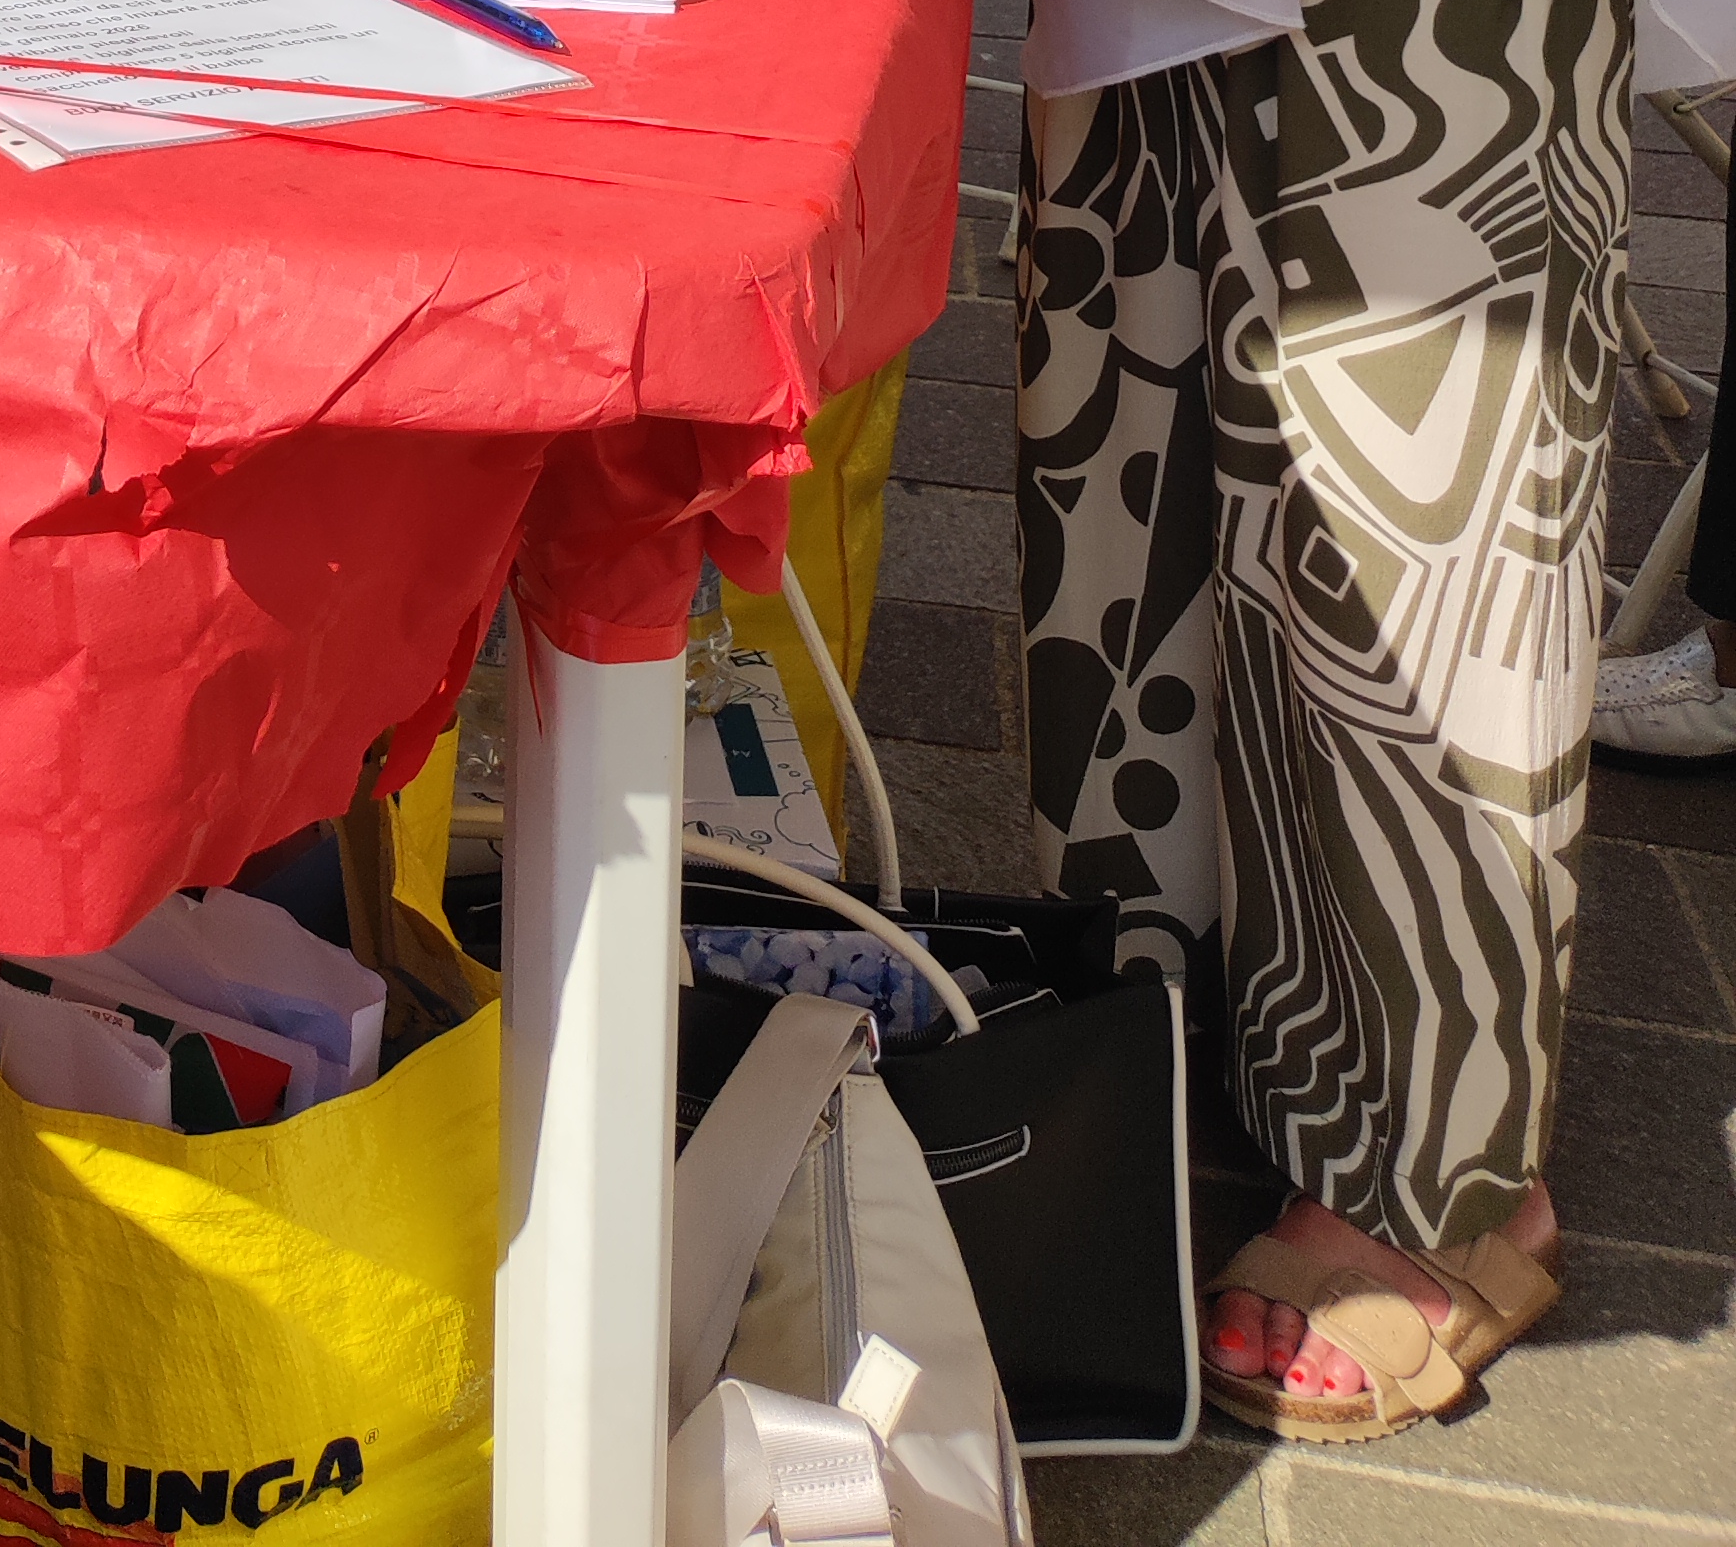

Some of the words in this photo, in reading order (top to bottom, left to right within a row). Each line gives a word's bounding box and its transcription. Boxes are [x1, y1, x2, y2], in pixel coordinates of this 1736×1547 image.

[22, 19, 83, 32] corso
[85, 11, 124, 26] che
[47, 4, 94, 18] mail
[16, 29, 99, 47] gennaio
[100, 23, 152, 36] 2026
[88, 29, 195, 50] pieghevoli
[194, 41, 276, 59] biglietti
[277, 33, 349, 48] donare
[349, 28, 380, 39] un
[94, 41, 176, 59] biglietti
[178, 36, 228, 49] della
[32, 74, 138, 94] sacchetto
[201, 56, 265, 71] bulbo
[136, 85, 242, 108] SERVIZIO
